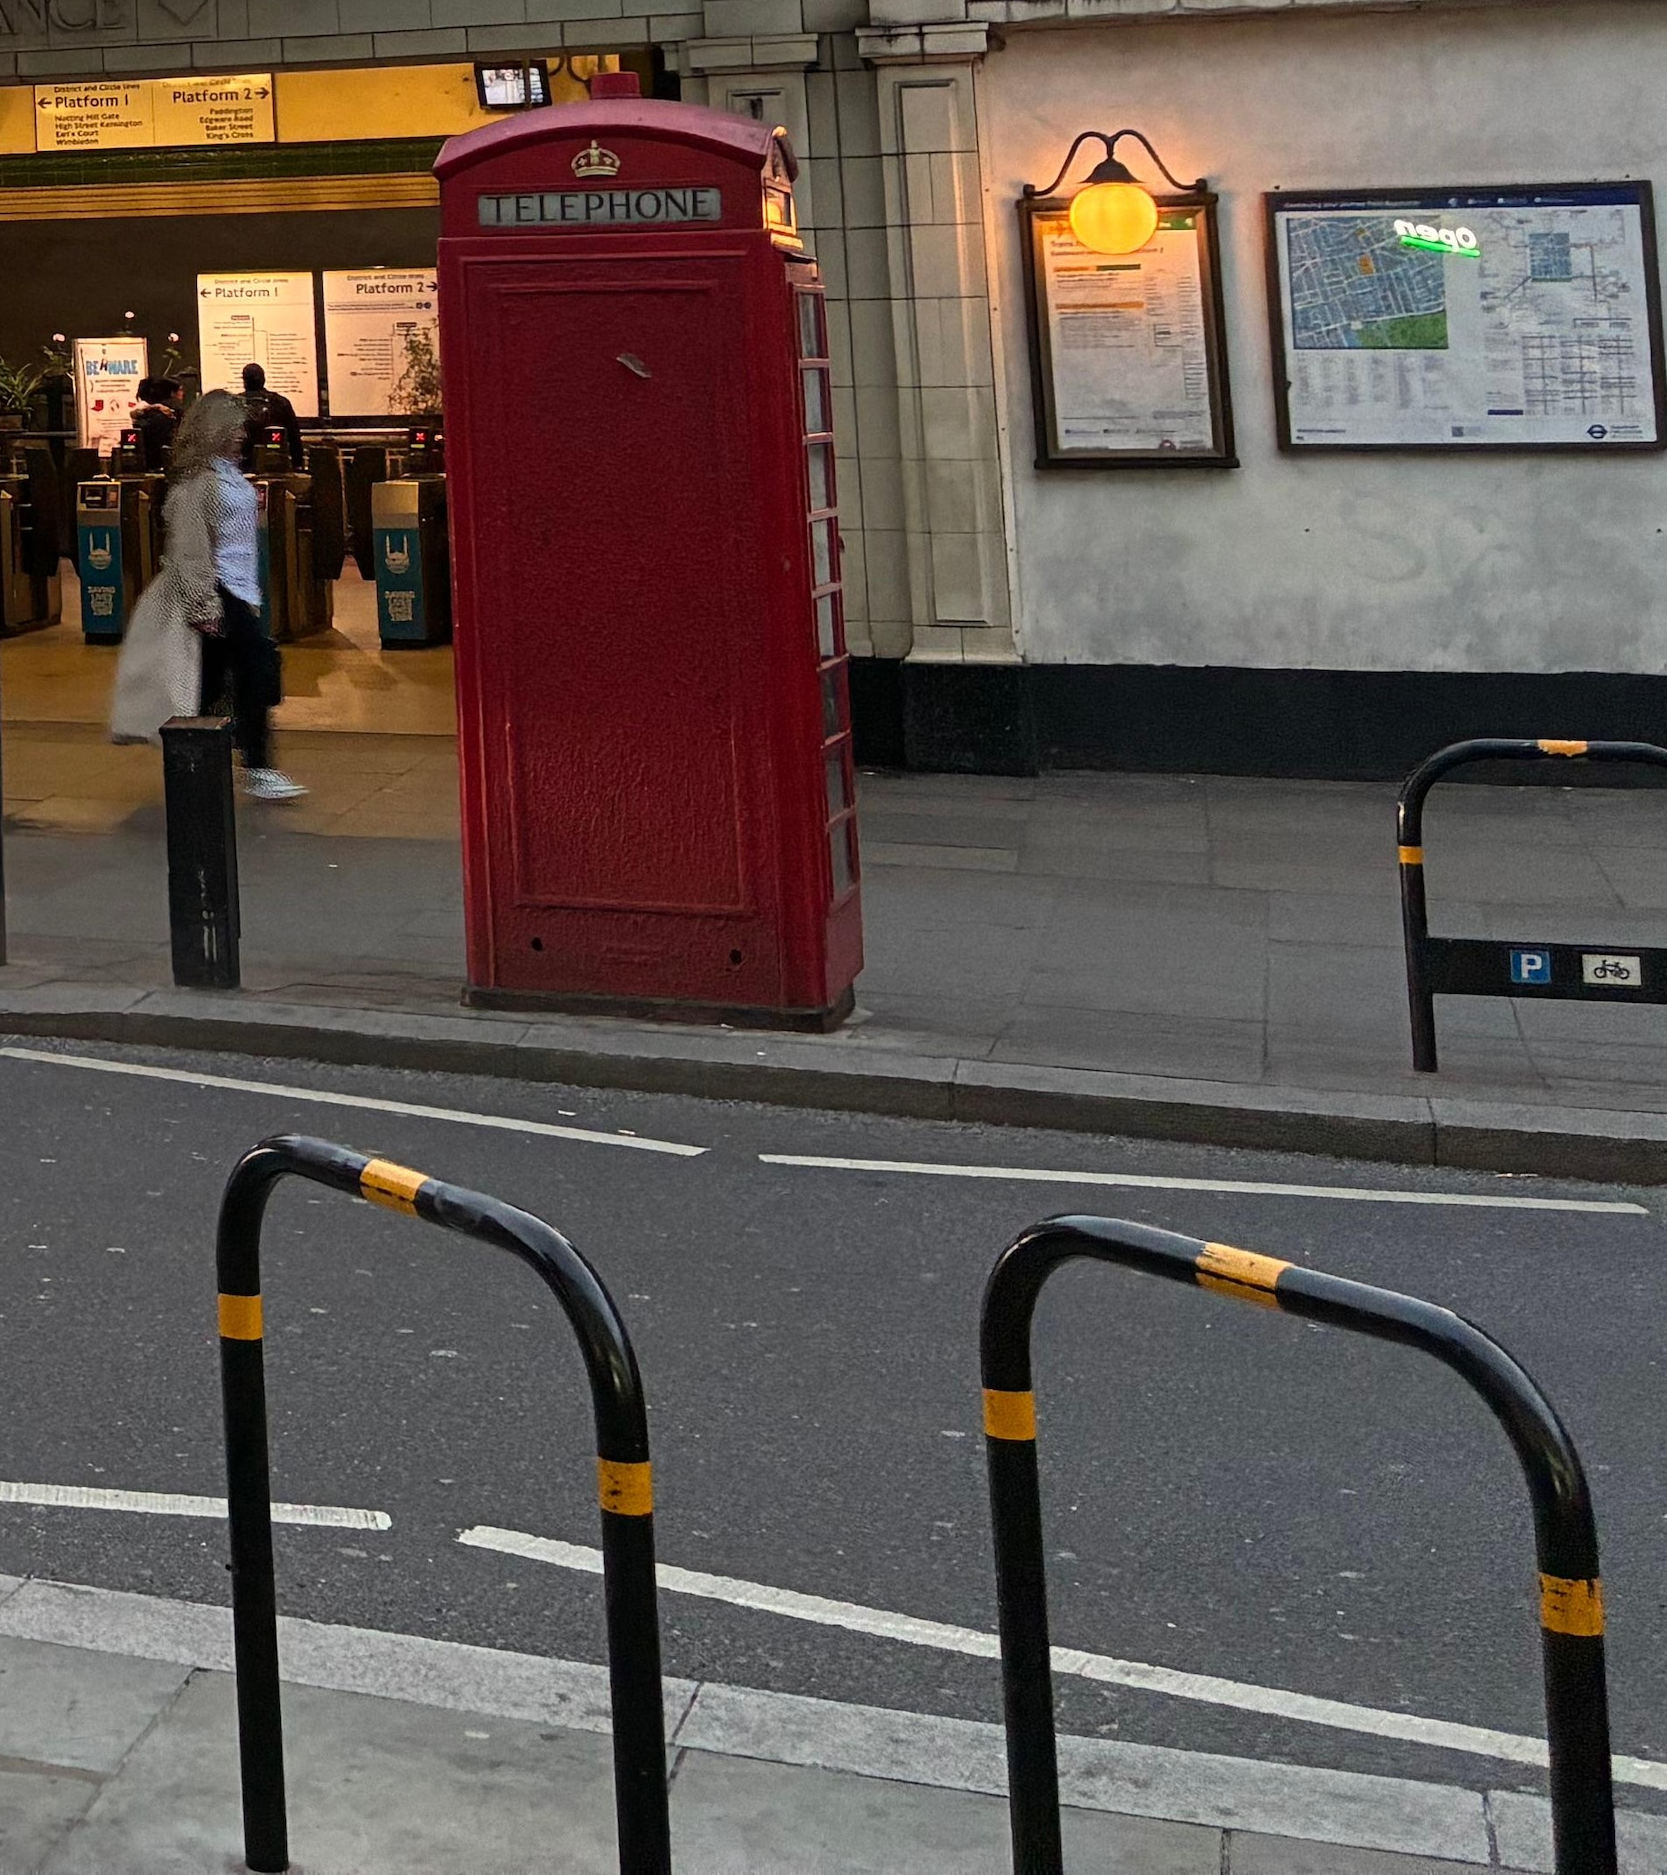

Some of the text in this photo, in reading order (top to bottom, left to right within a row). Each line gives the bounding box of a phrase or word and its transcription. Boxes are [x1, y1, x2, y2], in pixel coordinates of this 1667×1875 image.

[55, 94, 129, 108] Platform 1
[173, 88, 252, 104] Platform 2
[77, 129, 99, 137] Court
[484, 188, 711, 223] TELEPHONE
[215, 287, 270, 298] Platform
[356, 282, 425, 294] Platform 2
[1520, 953, 1543, 979] P
